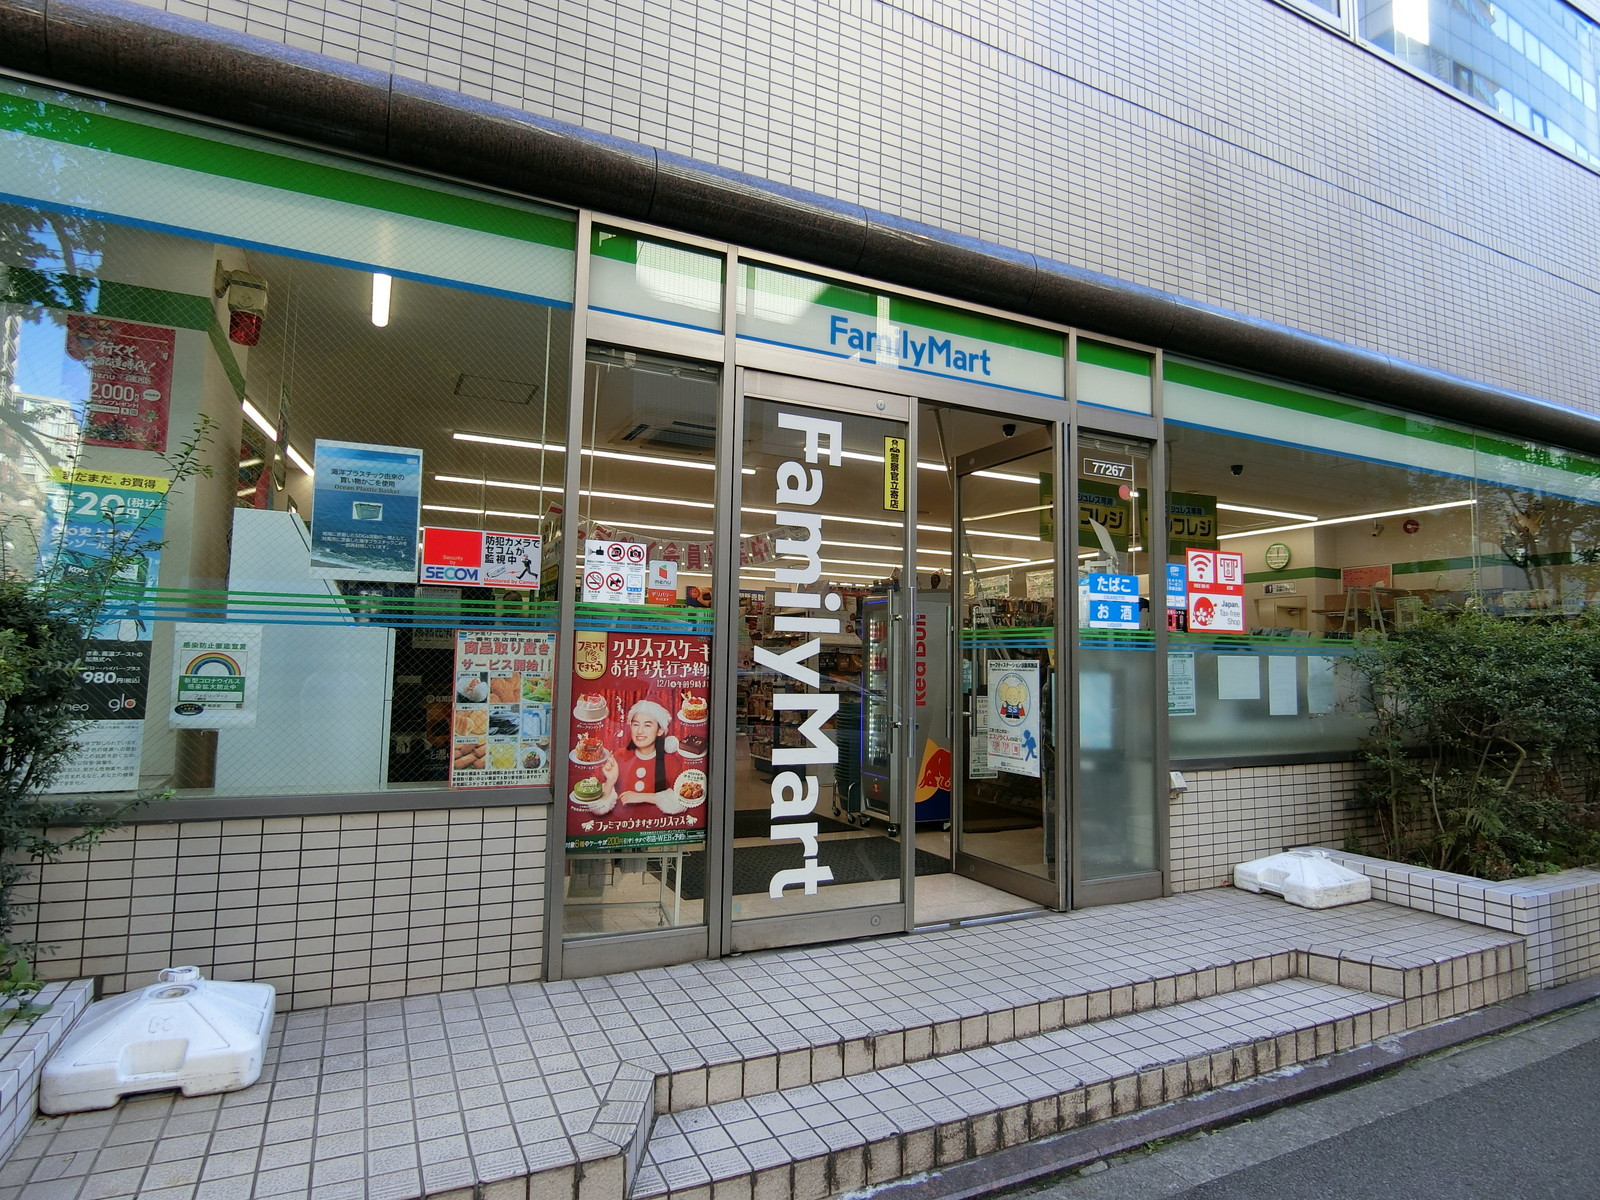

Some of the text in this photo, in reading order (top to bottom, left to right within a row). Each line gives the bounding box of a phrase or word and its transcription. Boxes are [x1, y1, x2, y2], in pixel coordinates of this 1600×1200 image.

[830, 315, 991, 376] FamilyMart
[330, 468, 405, 481] 海洋プラスチック由来の
[1091, 461, 1126, 478] 77267
[339, 476, 396, 488] 買い物かごを使用
[889, 452, 900, 509] 警察官立寄店
[355, 485, 377, 493] Plastic
[378, 487, 400, 495] Basket
[485, 535, 540, 549] 防犯カメラで
[442, 554, 464, 562] Security
[485, 546, 525, 557] セコムが
[484, 554, 517, 565] 監視中
[425, 566, 479, 581] SECOM
[483, 577, 510, 585] Monitored
[1096, 576, 1132, 593] たばこ
[1221, 600, 1240, 609] Japan.
[1219, 609, 1240, 618] Tax-free
[1227, 617, 1240, 627] Shop
[464, 641, 550, 656] 商品取り置き
[611, 637, 710, 662] クリスマスケーキ
[754, 412, 842, 898] FamilyMart
[577, 661, 604, 672] できちゃう
[63, 703, 90, 711] neo
[108, 693, 137, 713] glo
[595, 814, 686, 832] ファミマのうますぎクリスマス
